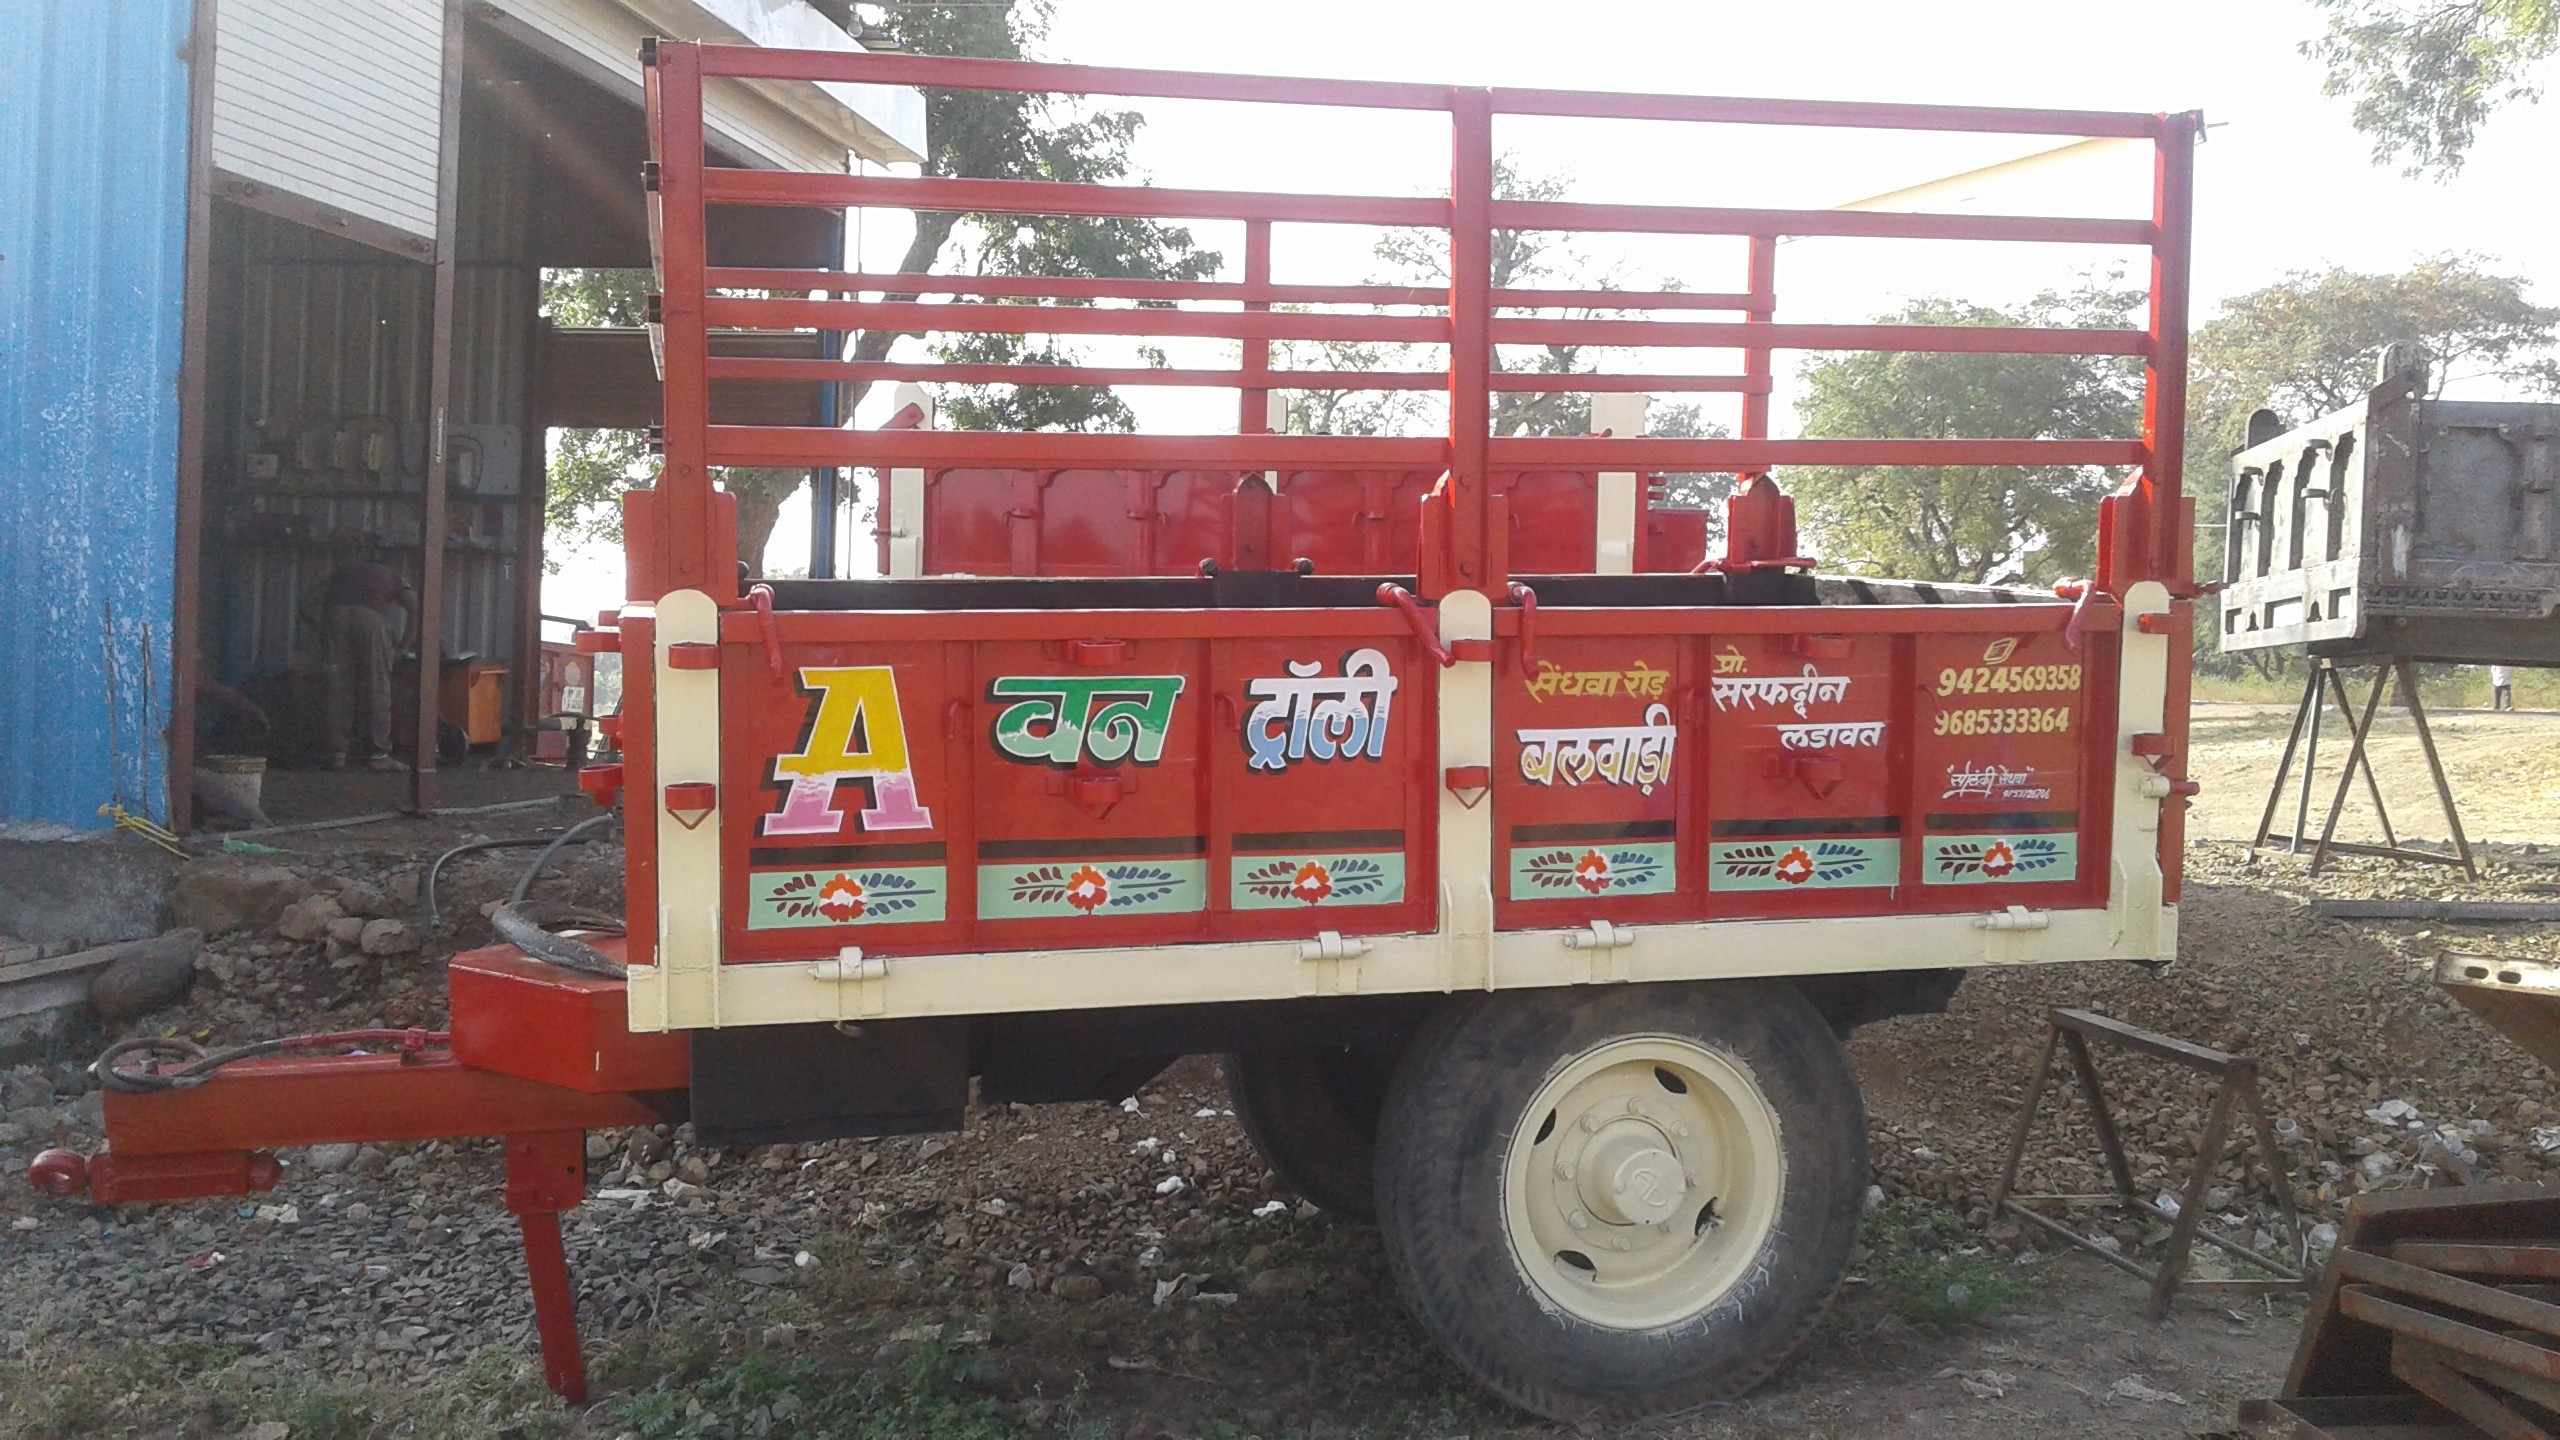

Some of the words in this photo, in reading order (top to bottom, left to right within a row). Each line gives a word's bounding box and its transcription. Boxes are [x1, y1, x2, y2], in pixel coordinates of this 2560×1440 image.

[1525, 660, 1622, 703] सेंधवा
[1936, 664, 2082, 697] 9424569358
[764, 665, 932, 836] A
[993, 675, 1185, 762] वन
[1247, 648, 1398, 769] ट्रॉली
[1933, 707, 2070, 735] 9685333364
[1516, 703, 1677, 796] बलवाड़ी
